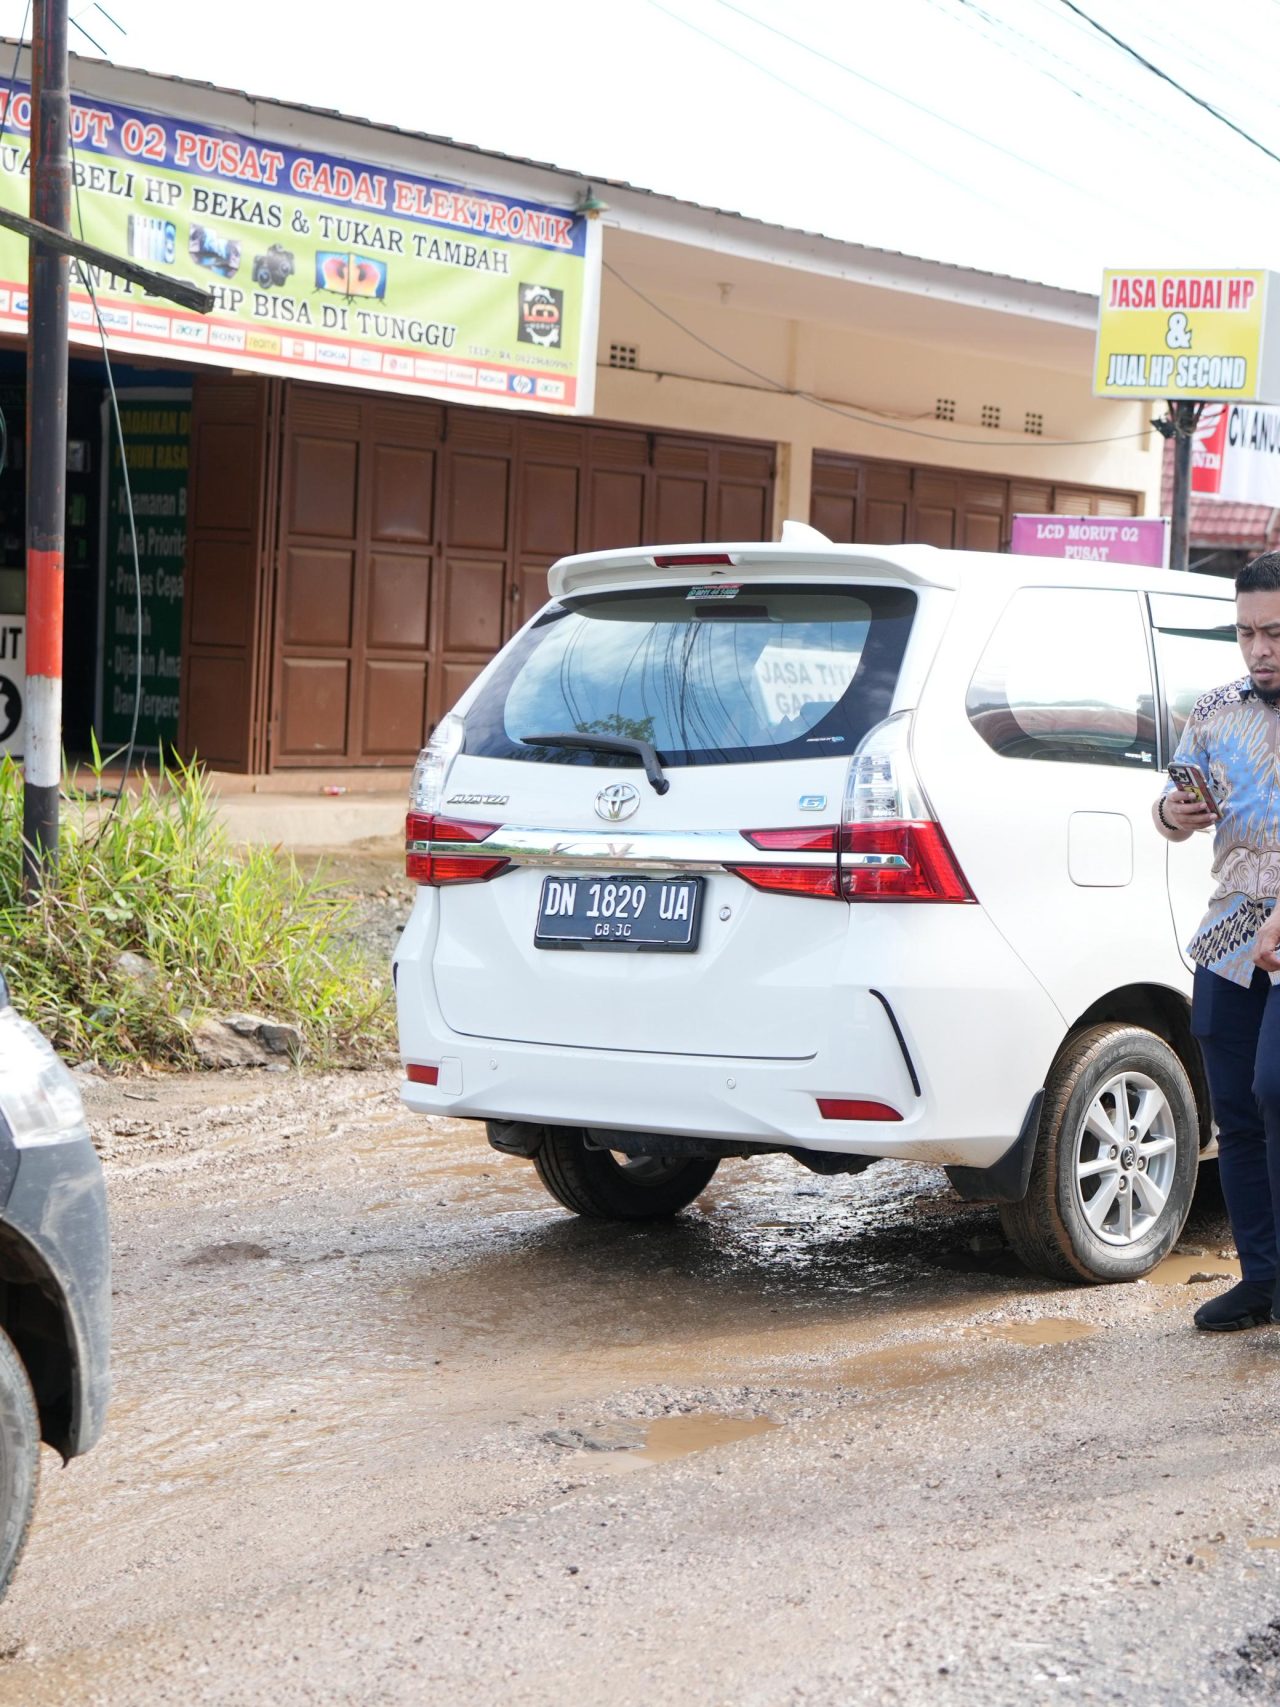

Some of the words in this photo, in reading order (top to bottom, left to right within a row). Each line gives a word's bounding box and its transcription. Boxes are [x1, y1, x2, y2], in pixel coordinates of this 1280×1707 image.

[121, 118, 167, 160] 02
[175, 131, 285, 186] PUSAT
[290, 160, 386, 207] GADAI
[393, 182, 573, 247] ELEKTRONIK
[71, 161, 133, 198] BELI
[145, 178, 182, 207] HP
[192, 188, 282, 227] BEKAS
[291, 209, 310, 234] &
[319, 214, 404, 253] TUKAR
[412, 234, 511, 275] TAMBAH
[1109, 279, 1156, 308] JASA
[1162, 279, 1222, 309] GADAI
[1228, 280, 1254, 309] HP
[208, 284, 244, 312] HP
[253, 293, 313, 326] BISA
[322, 305, 348, 331] DI
[356, 310, 457, 349] TUNGGU
[523, 303, 560, 324] LCD
[211, 330, 244, 345] SONY
[1166, 311, 1192, 349] &
[1106, 353, 1147, 386] JUAL
[1148, 354, 1174, 387] HP
[1175, 355, 1247, 389] SECOND
[118, 486, 176, 516] Kamanan
[117, 526, 145, 555] Ana
[1036, 524, 1065, 540] LCD
[1068, 526, 1118, 542] MORUT
[1121, 527, 1139, 542] 02
[1064, 545, 1110, 561] PUSAT
[116, 566, 153, 596] Proes
[761, 661, 813, 686] JASA
[545, 882, 577, 916] DN
[586, 884, 646, 918] 1829
[659, 886, 690, 921] UA
